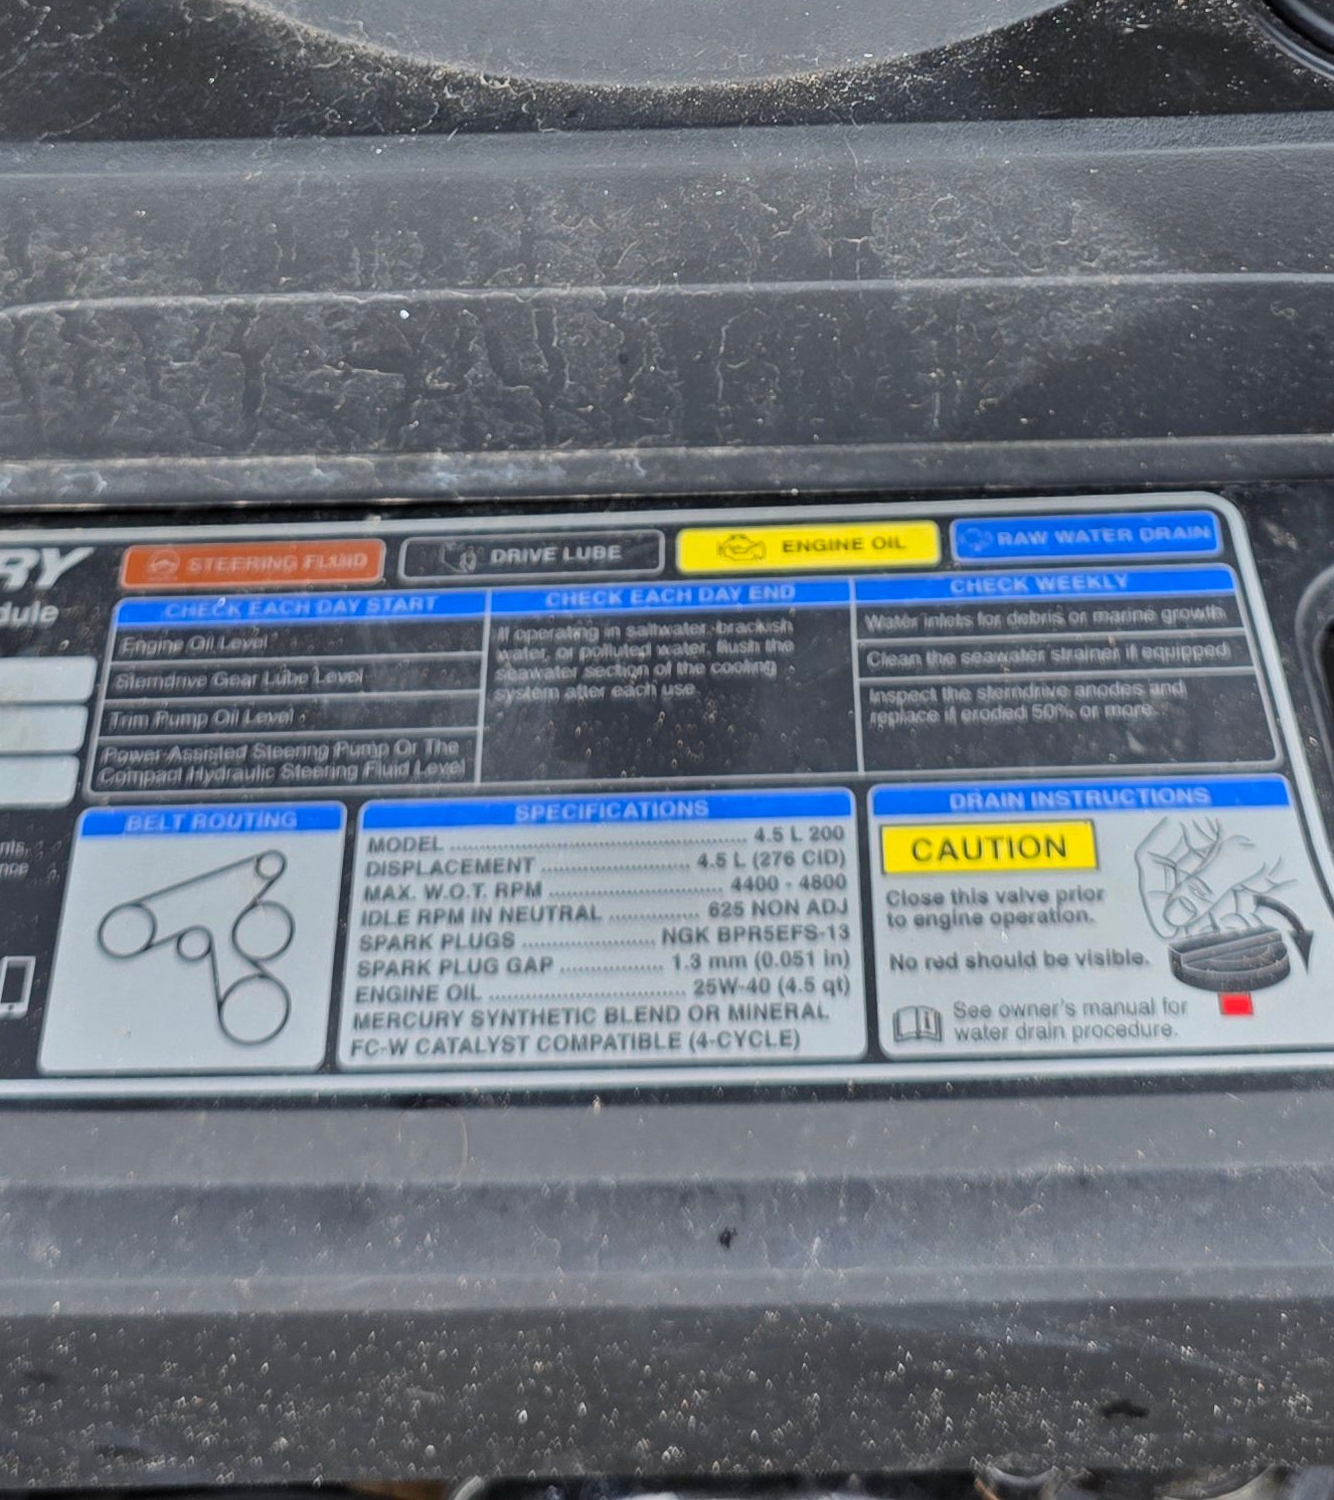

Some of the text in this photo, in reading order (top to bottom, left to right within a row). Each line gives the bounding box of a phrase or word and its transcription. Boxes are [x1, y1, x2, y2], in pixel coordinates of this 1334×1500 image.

[782, 535, 907, 554] ENGINE OIL
[997, 524, 1212, 547] RAW WATER DRAIN
[188, 552, 368, 573] STEERING FLUID
[491, 545, 622, 565] DRIVE LUBE
[546, 584, 796, 608] CHECK EACH DAY END
[950, 573, 1129, 595] CHECK WEEKLY
[166, 596, 438, 619] CHECK EACH DAY START
[865, 605, 1227, 631] Water inlets for debris or marine growth
[119, 633, 268, 657] Engine Oil Level
[867, 642, 1228, 667] Clean the seawater strainer if equipped
[869, 680, 1187, 706] Inspect the sterndrive anodes and
[108, 707, 295, 730] Trim Pump Oil Level
[869, 703, 1158, 727] replace if eroded 50% or more.
[949, 786, 1211, 812] DRAIN INSTRUCTIONS
[126, 811, 298, 833] BELT ROUTING
[515, 800, 710, 823] SPECIFICATIONS
[367, 825, 845, 854] MODEL 4.5 L 200
[912, 834, 1067, 863] CAUTION
[366, 849, 846, 878] DISPLACEMENT 4.5 L (276 CID)
[364, 884, 416, 901] MAX.
[424, 883, 489, 900] W.O.T.
[495, 881, 543, 897] RPM
[730, 876, 780, 893] 4400
[799, 875, 847, 891] 4800
[886, 886, 1105, 906] Close this valve prior
[361, 899, 849, 927] IDLE RPM IN NEUTRAL 625 NON ADJ
[887, 907, 1095, 930] to engine operation.
[359, 925, 850, 952] SPARK PLUGS NGK BPR5EFS-13
[357, 951, 850, 978] SPARK PLUG GAP 1.3 mm (0.051 in)
[890, 950, 1151, 970] No red should be visible.
[355, 977, 851, 1004] ENGINE OIL 25W-40 (4.5 qt)
[353, 1003, 829, 1031] MERCURY SYNTHETIC BLEND OR MINERAL
[953, 998, 1187, 1018] See owner's manual for
[350, 1029, 801, 1057] FC-W CATALYST COMPATIBLE (4-CYCLE)
[955, 1021, 1179, 1043] water drain procedure.
